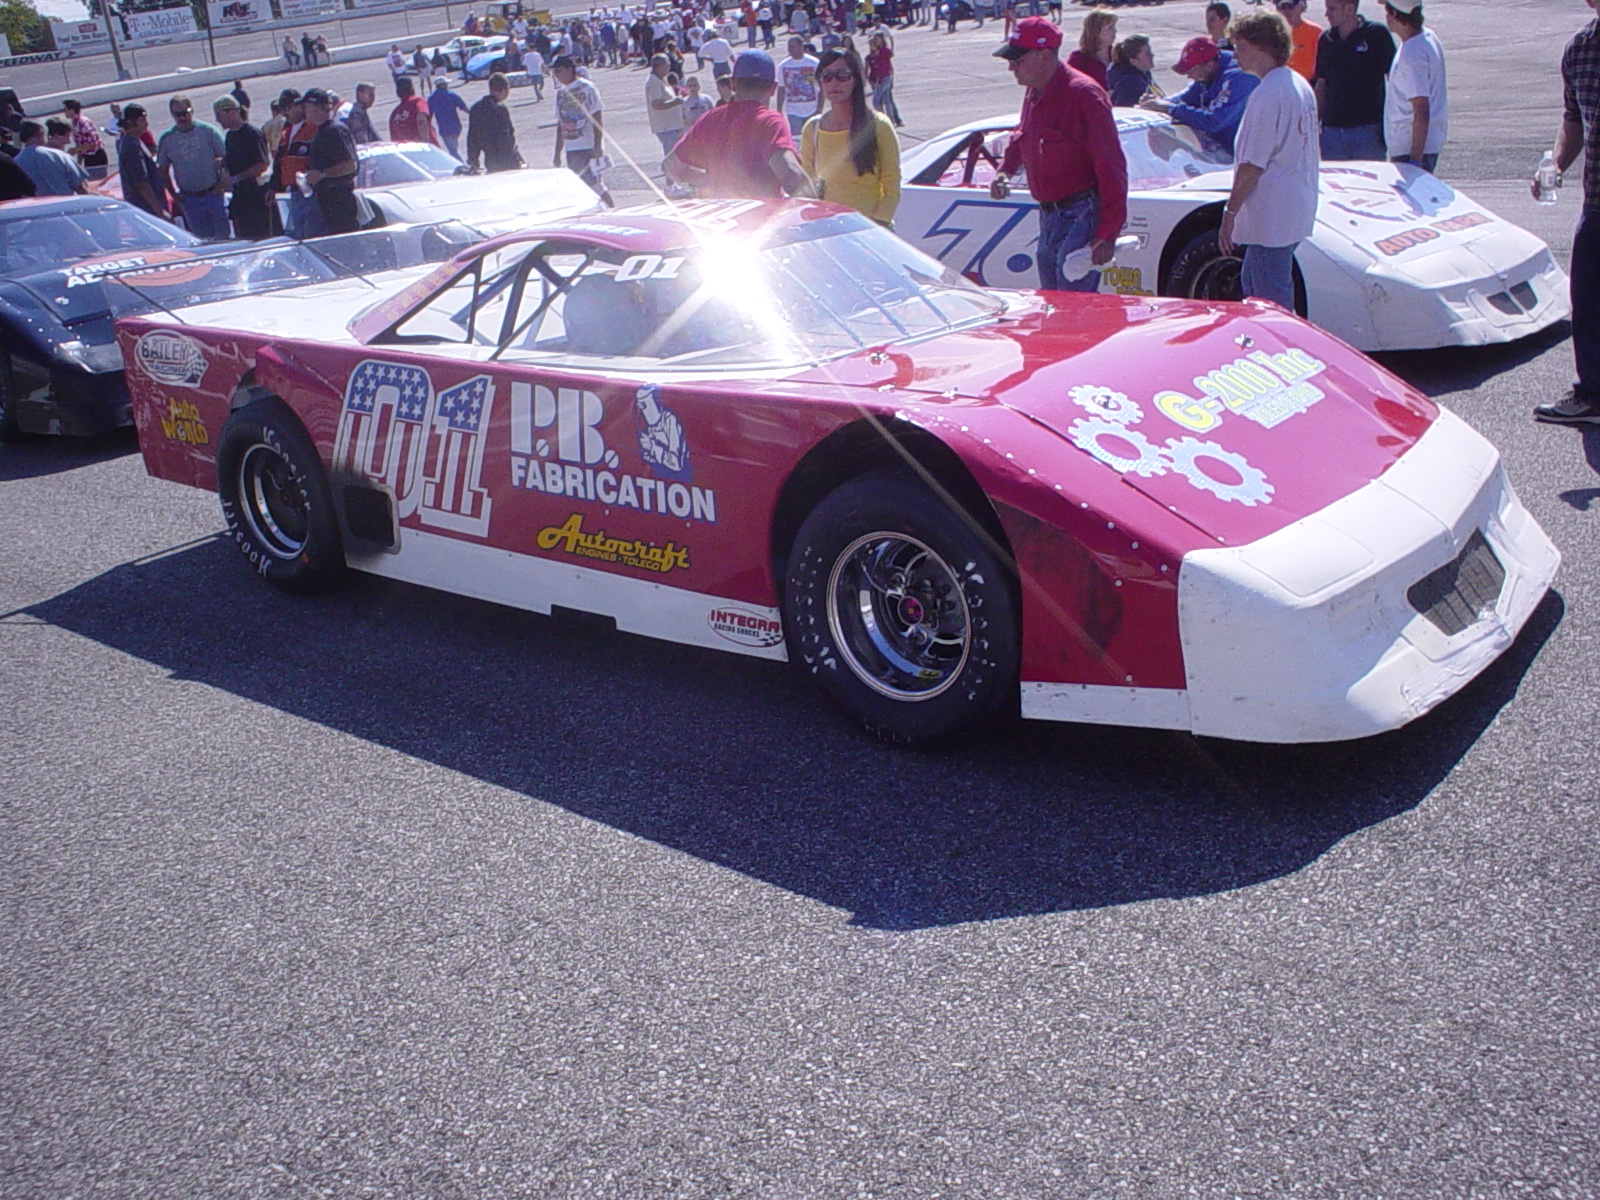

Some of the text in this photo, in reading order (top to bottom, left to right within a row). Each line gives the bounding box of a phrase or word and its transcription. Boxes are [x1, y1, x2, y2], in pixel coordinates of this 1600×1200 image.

[1373, 227, 1441, 257] AUTO
[57, 257, 146, 276] TARGET
[615, 254, 686, 282] 01
[141, 339, 189, 361] BAILEY
[511, 381, 620, 469] P.B.
[332, 359, 496, 538] 01
[511, 455, 717, 523] FABRICATION
[537, 513, 691, 572] Autocraft
[710, 609, 780, 634] INTEGRA
